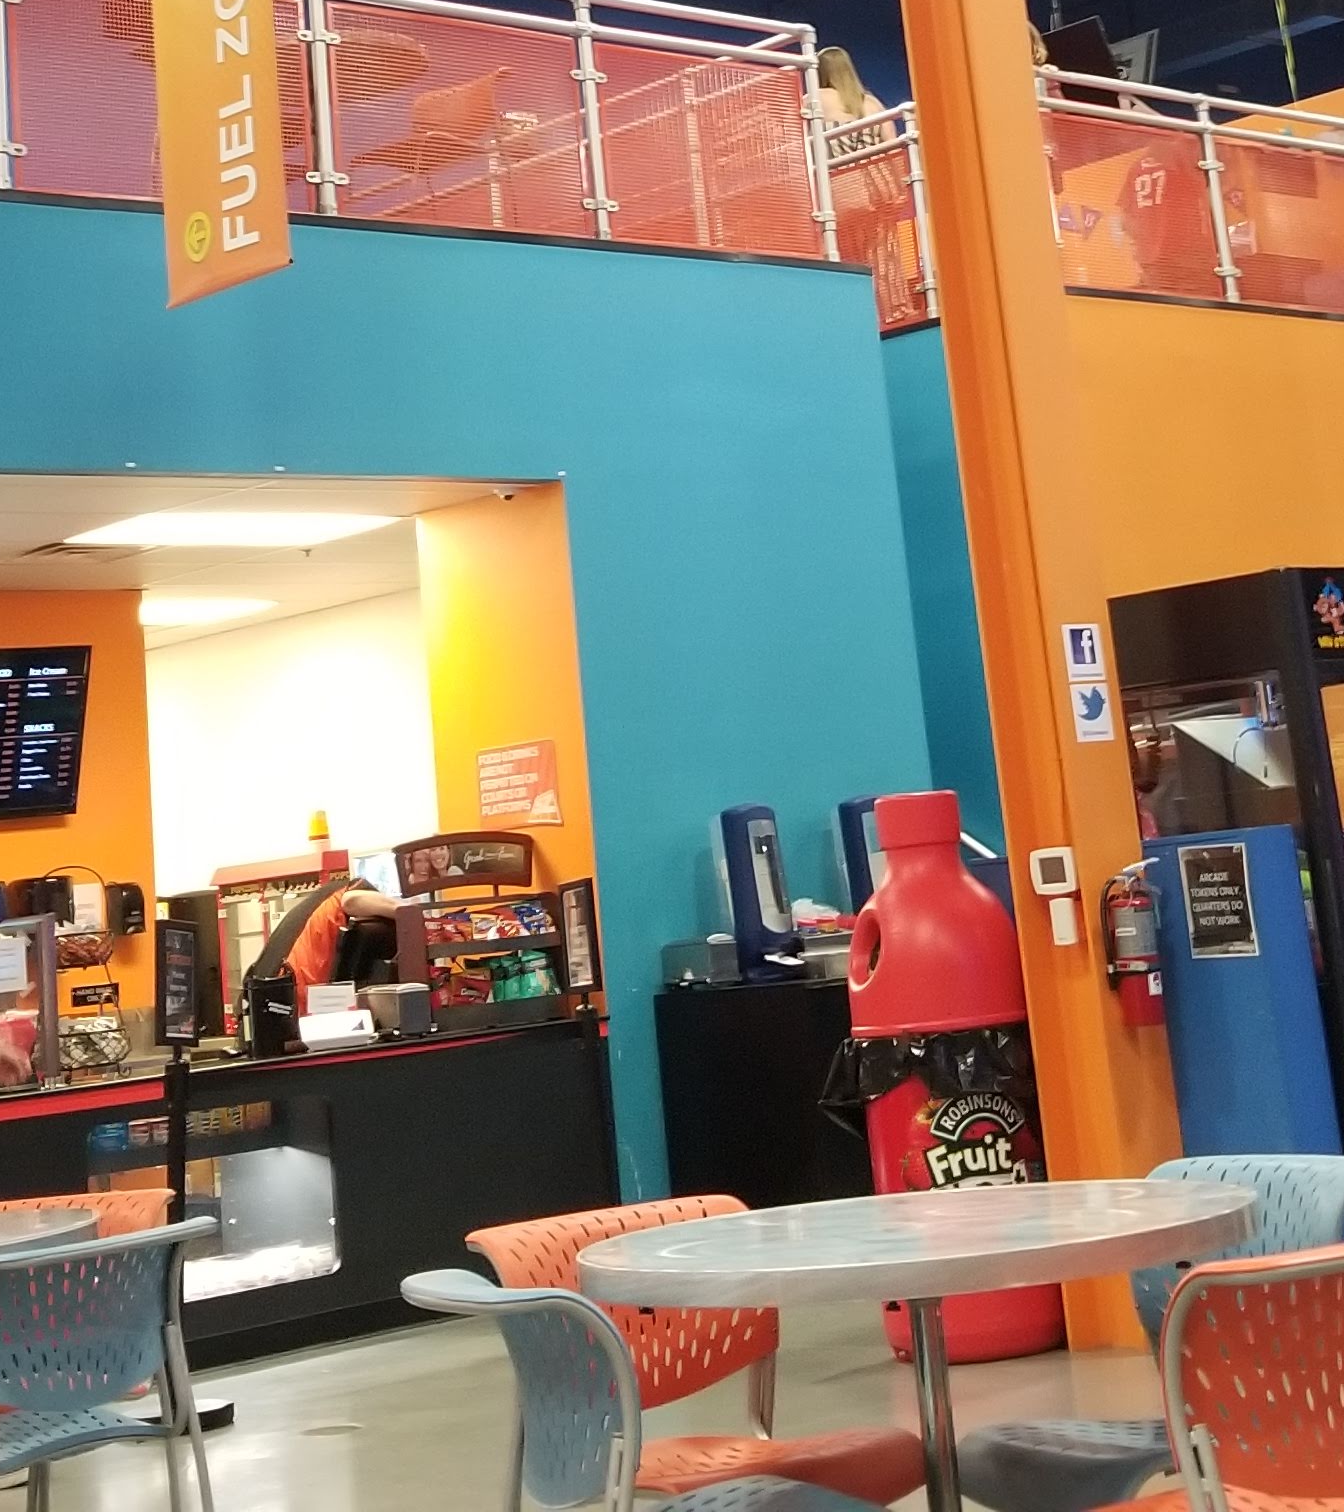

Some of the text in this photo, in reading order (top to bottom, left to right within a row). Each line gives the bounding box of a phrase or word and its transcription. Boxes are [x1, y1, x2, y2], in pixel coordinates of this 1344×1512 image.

[218, 73, 262, 254] FUEL
[478, 752, 502, 766] FOOD
[1199, 871, 1229, 883] ARCADE
[1190, 886, 1218, 898] TOKENS
[1231, 900, 1244, 911] DO
[1199, 914, 1241, 926] NOT WORK
[939, 1093, 1016, 1131] ROBINSONS
[926, 1133, 1013, 1186] Fruit
